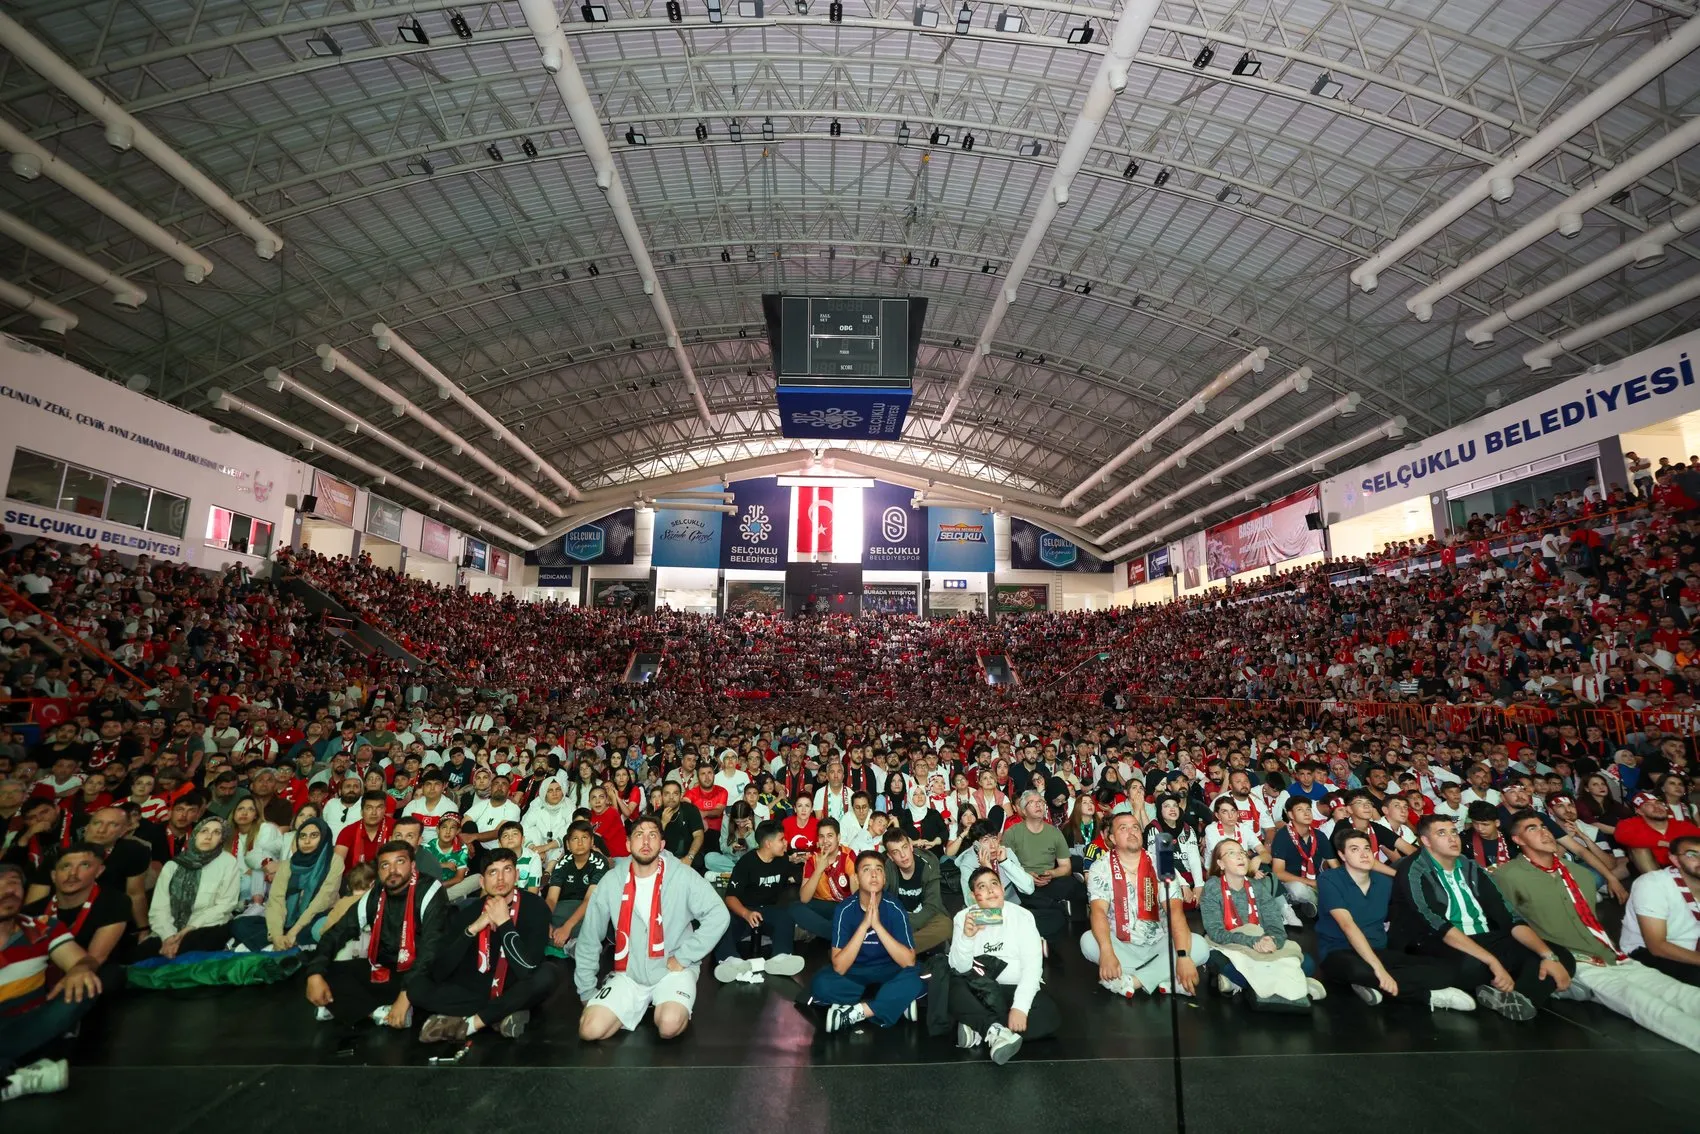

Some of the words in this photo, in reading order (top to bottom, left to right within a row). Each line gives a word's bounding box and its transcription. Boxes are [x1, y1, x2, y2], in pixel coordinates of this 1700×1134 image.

[0, 385, 41, 408] CUNUN
[130, 432, 171, 454] ZAMANDA
[868, 402, 886, 435] SELÇUKLU
[1361, 440, 1476, 497] SELÇUKLU
[1485, 352, 1695, 455] BELEDİYESİ
[671, 518, 705, 528] SELÇUKLU
[4, 510, 97, 540] SELÇUKLU
[101, 530, 181, 557] BELEDİYESİ
[570, 531, 600, 541] SELÇUKLU
[940, 531, 982, 540] SELÇUKLU
[1043, 538, 1073, 548] SELÇUKLU
[731, 546, 778, 556] SELÇUKLU
[869, 547, 920, 555] SELÇUKLU
[730, 555, 778, 564] BELEDİYESİ
[595, 986, 612, 999] 10
